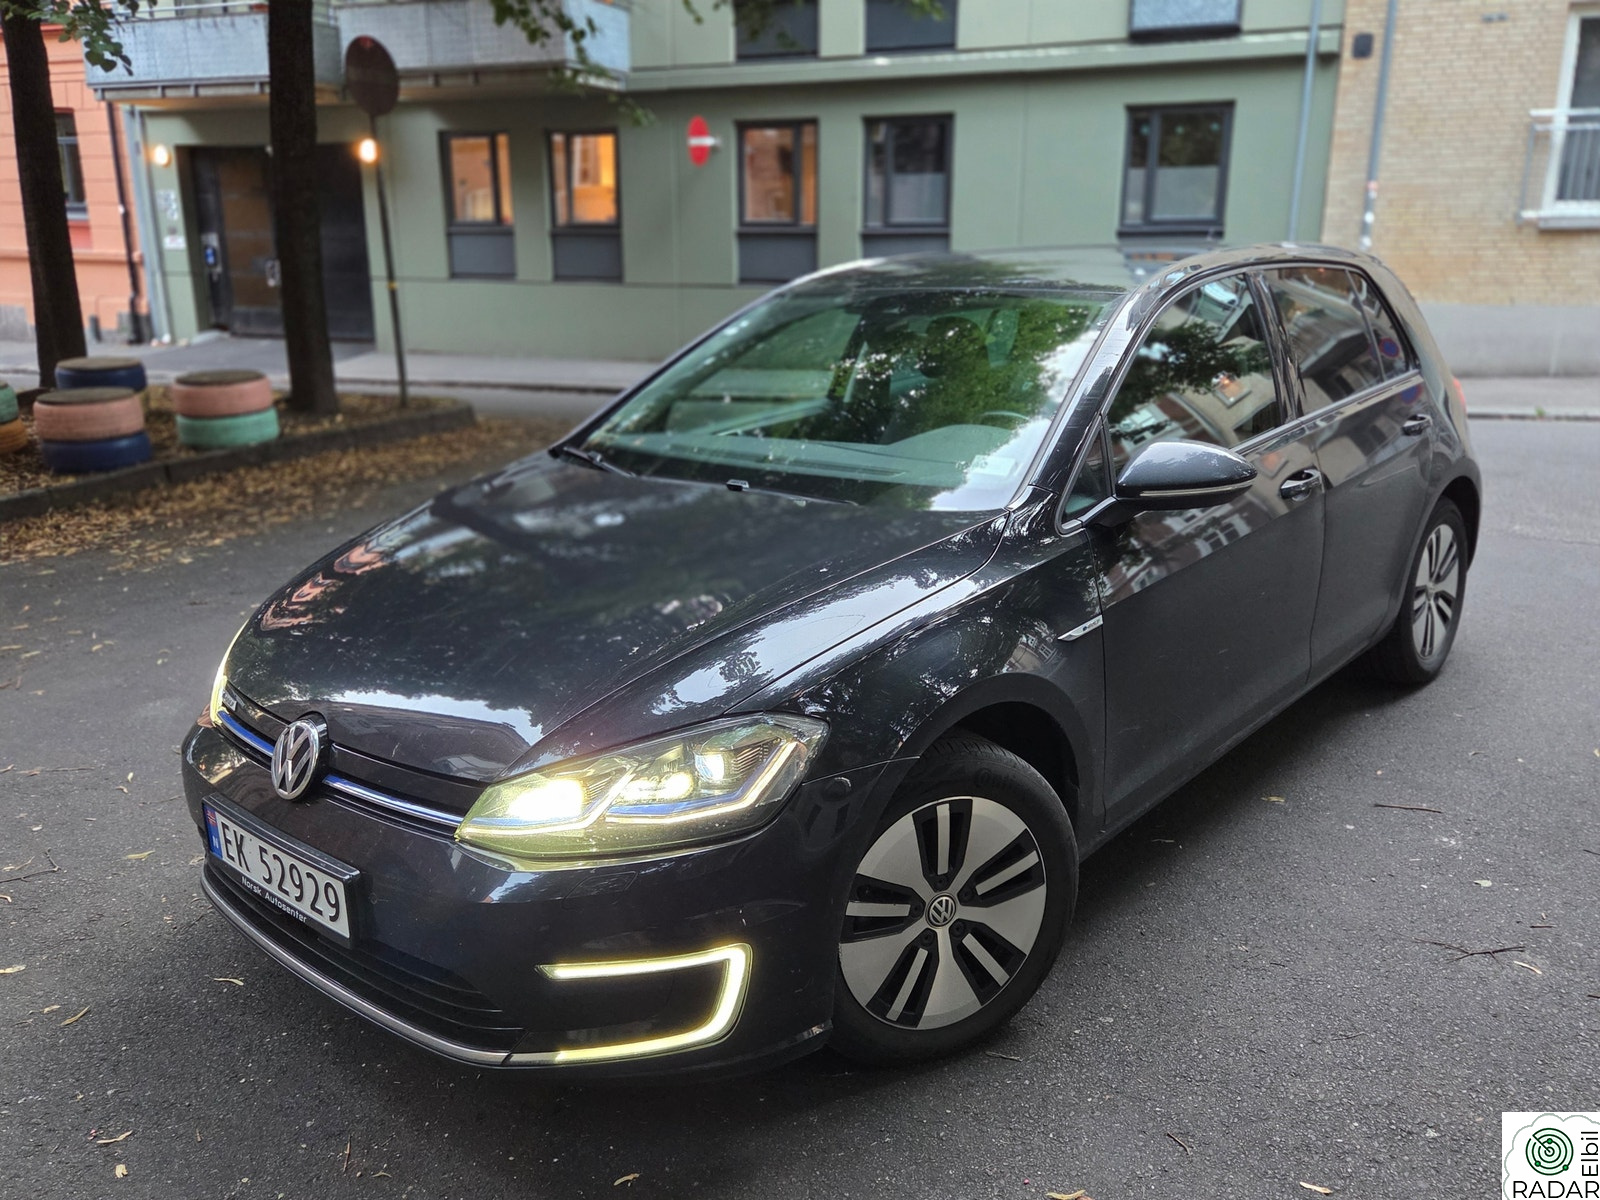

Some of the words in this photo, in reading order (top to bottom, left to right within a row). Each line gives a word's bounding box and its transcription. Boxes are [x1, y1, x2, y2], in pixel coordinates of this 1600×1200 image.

[220, 821, 251, 873] EK
[258, 844, 340, 922] 52929
[240, 876, 263, 896] Norsk
[264, 891, 308, 923] Autosenter
